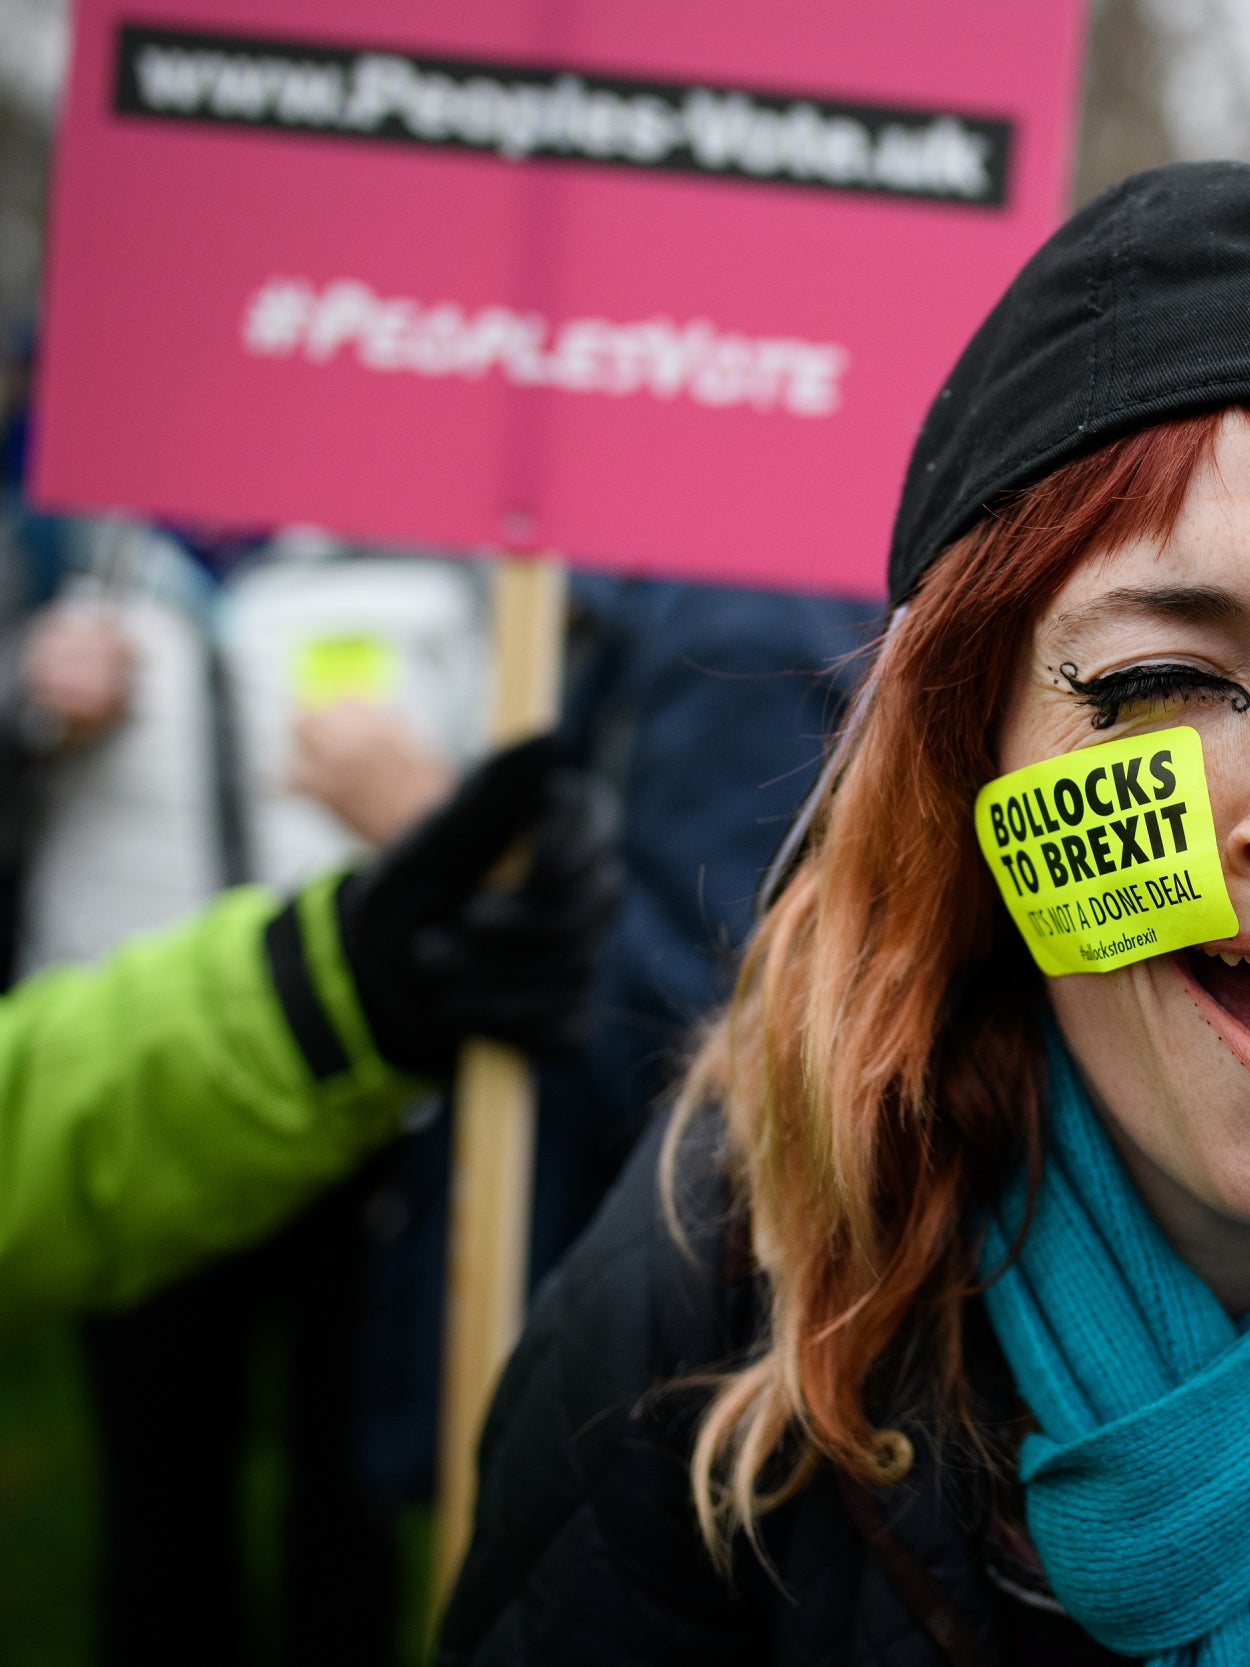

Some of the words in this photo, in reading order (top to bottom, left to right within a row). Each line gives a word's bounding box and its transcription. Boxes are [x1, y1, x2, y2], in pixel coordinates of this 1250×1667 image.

[138, 43, 991, 200] www.Peoples-Vote.uk
[990, 750, 1177, 847] BOLLOCKS
[1000, 850, 1040, 897] TO
[1041, 802, 1188, 888] BREXIT
[1048, 903, 1076, 934] NOT
[1076, 901, 1091, 930] A
[1088, 885, 1149, 926] DONE
[1145, 870, 1202, 908] DEAL
